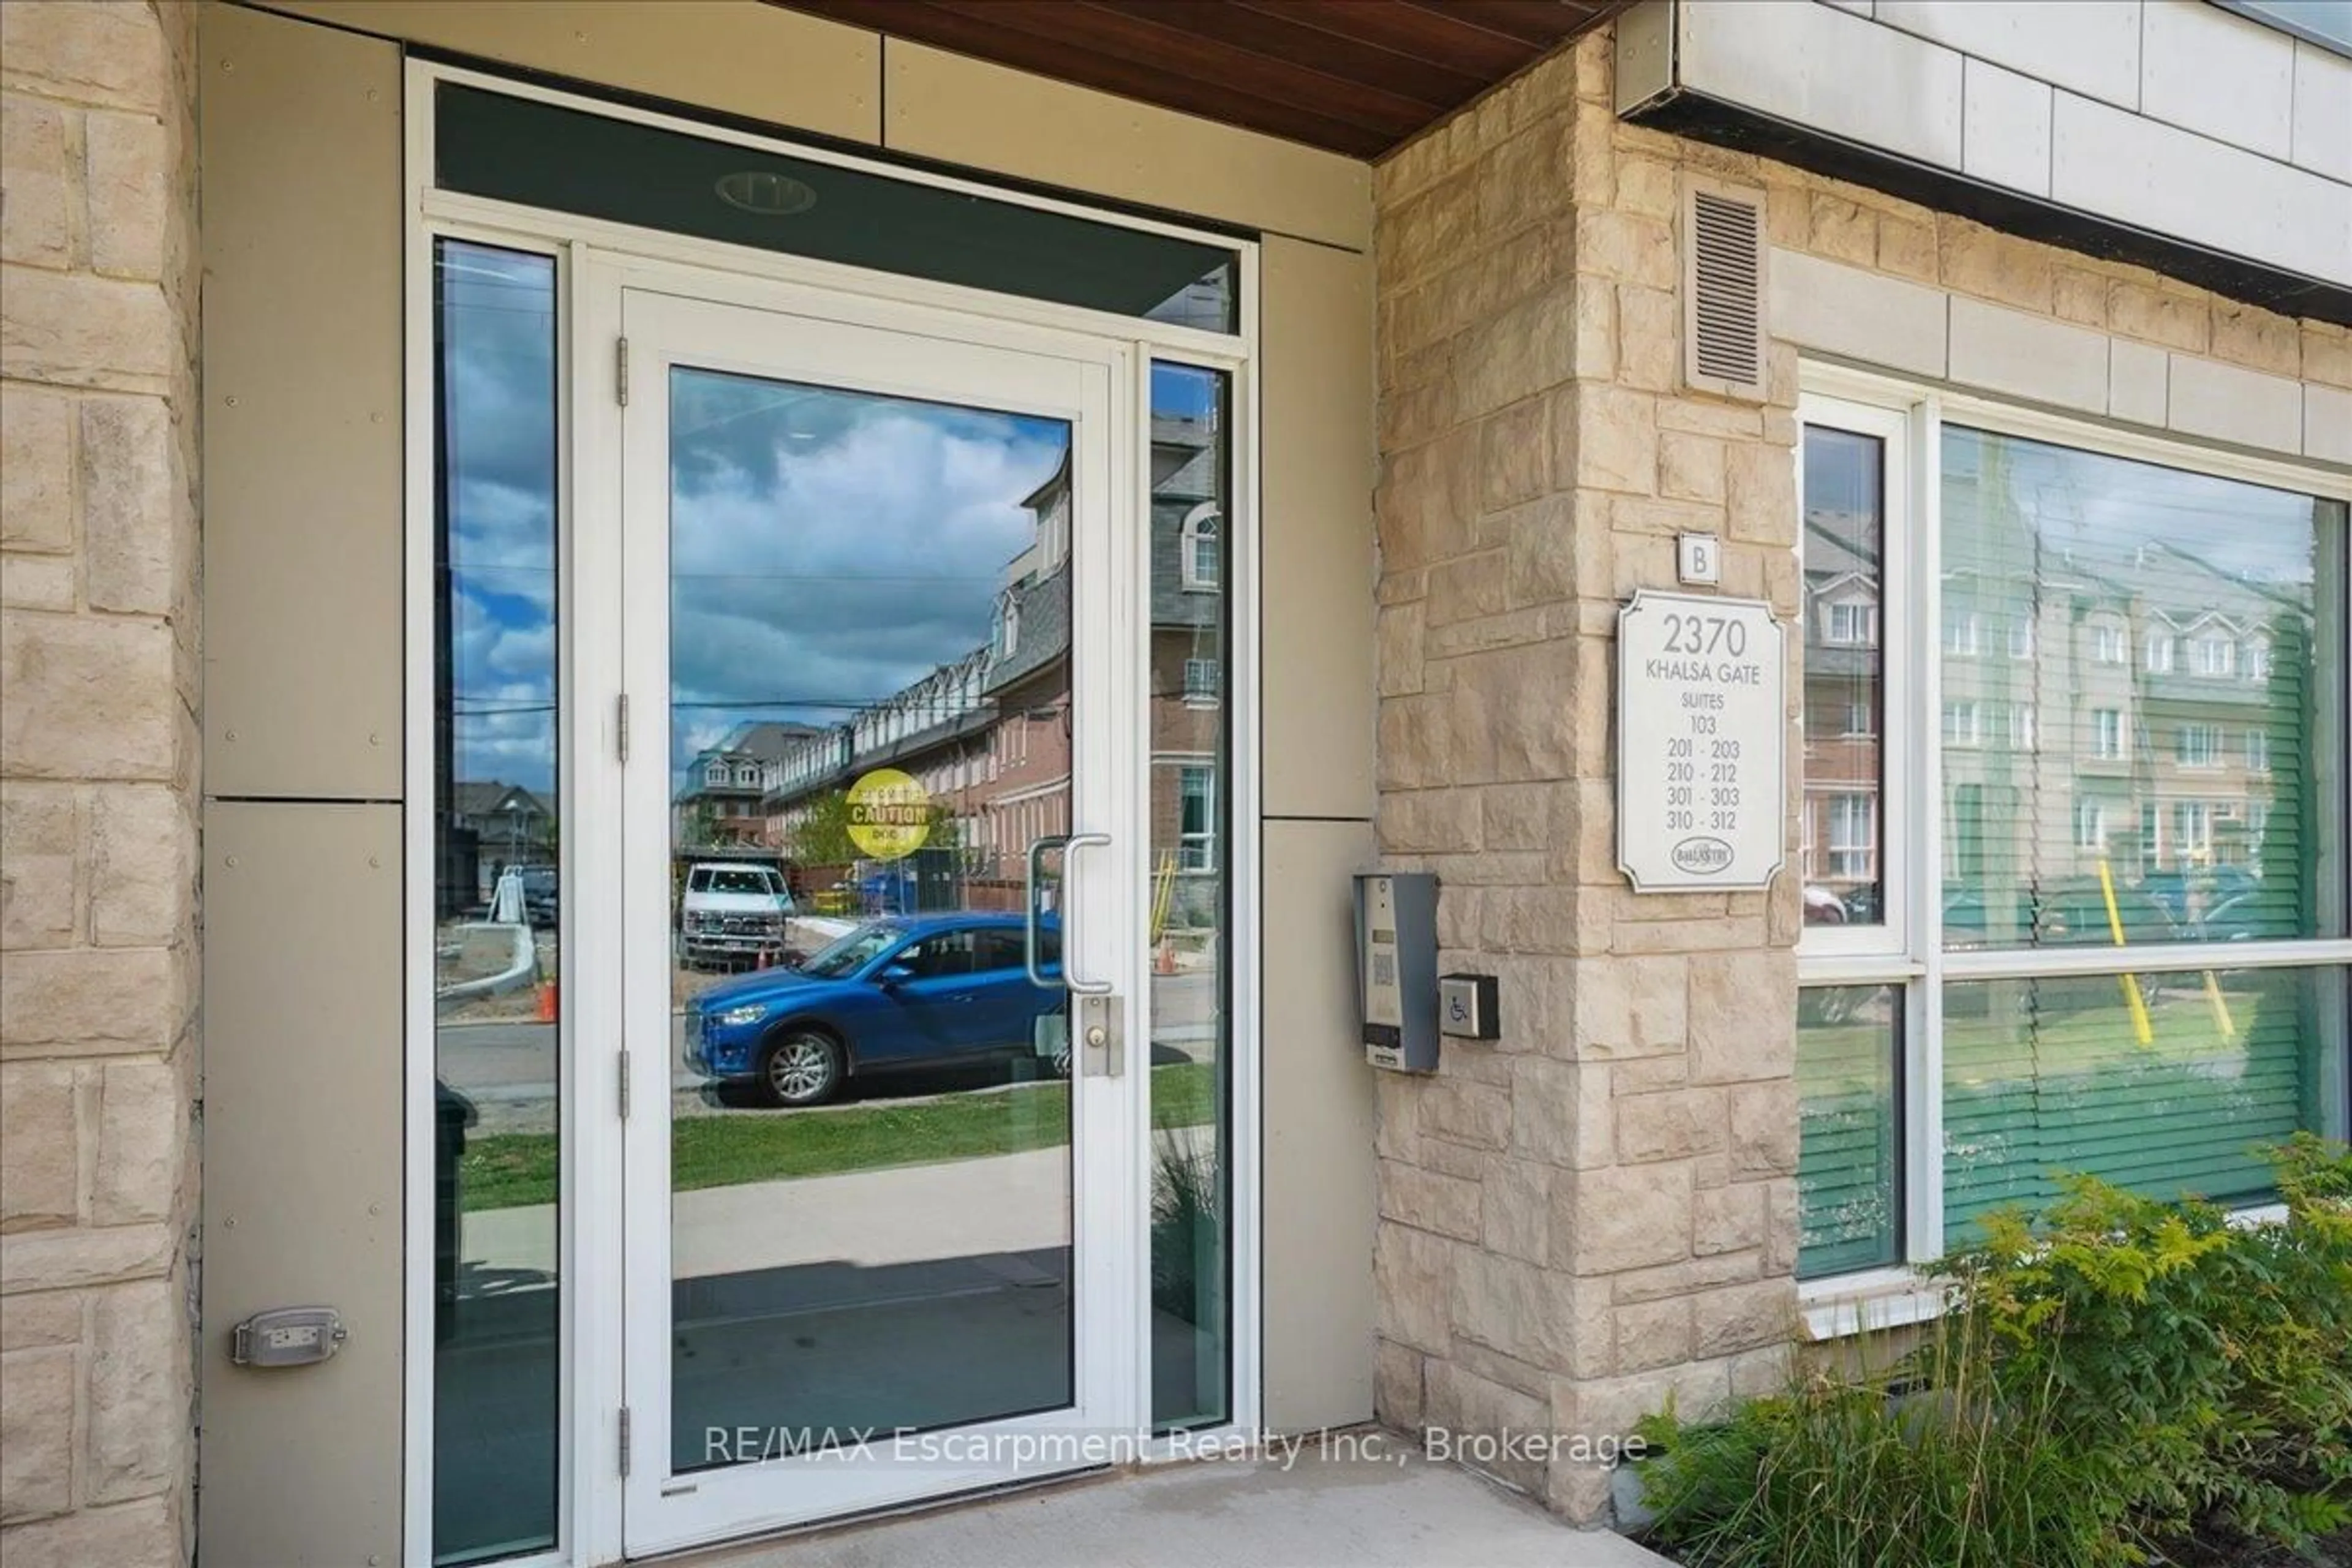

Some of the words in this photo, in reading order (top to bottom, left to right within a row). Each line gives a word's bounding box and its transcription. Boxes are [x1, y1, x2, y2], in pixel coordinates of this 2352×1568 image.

[1693, 546, 1707, 574] B
[1662, 613, 1746, 658] 2370
[1646, 658, 1713, 682] KHALSA
[1717, 662, 1760, 685] GATE
[1681, 692, 1724, 710] SUITES
[1691, 715, 1716, 735] 103
[1667, 737, 1692, 758] 201
[1711, 739, 1740, 760] 203
[1667, 762, 1694, 782] 210
[1711, 763, 1736, 783] 212
[1667, 786, 1692, 807] 301
[1711, 787, 1740, 807] 303
[852, 805, 926, 823] CAUTION
[1666, 810, 1694, 831] 310
[1710, 810, 1736, 830] 312
